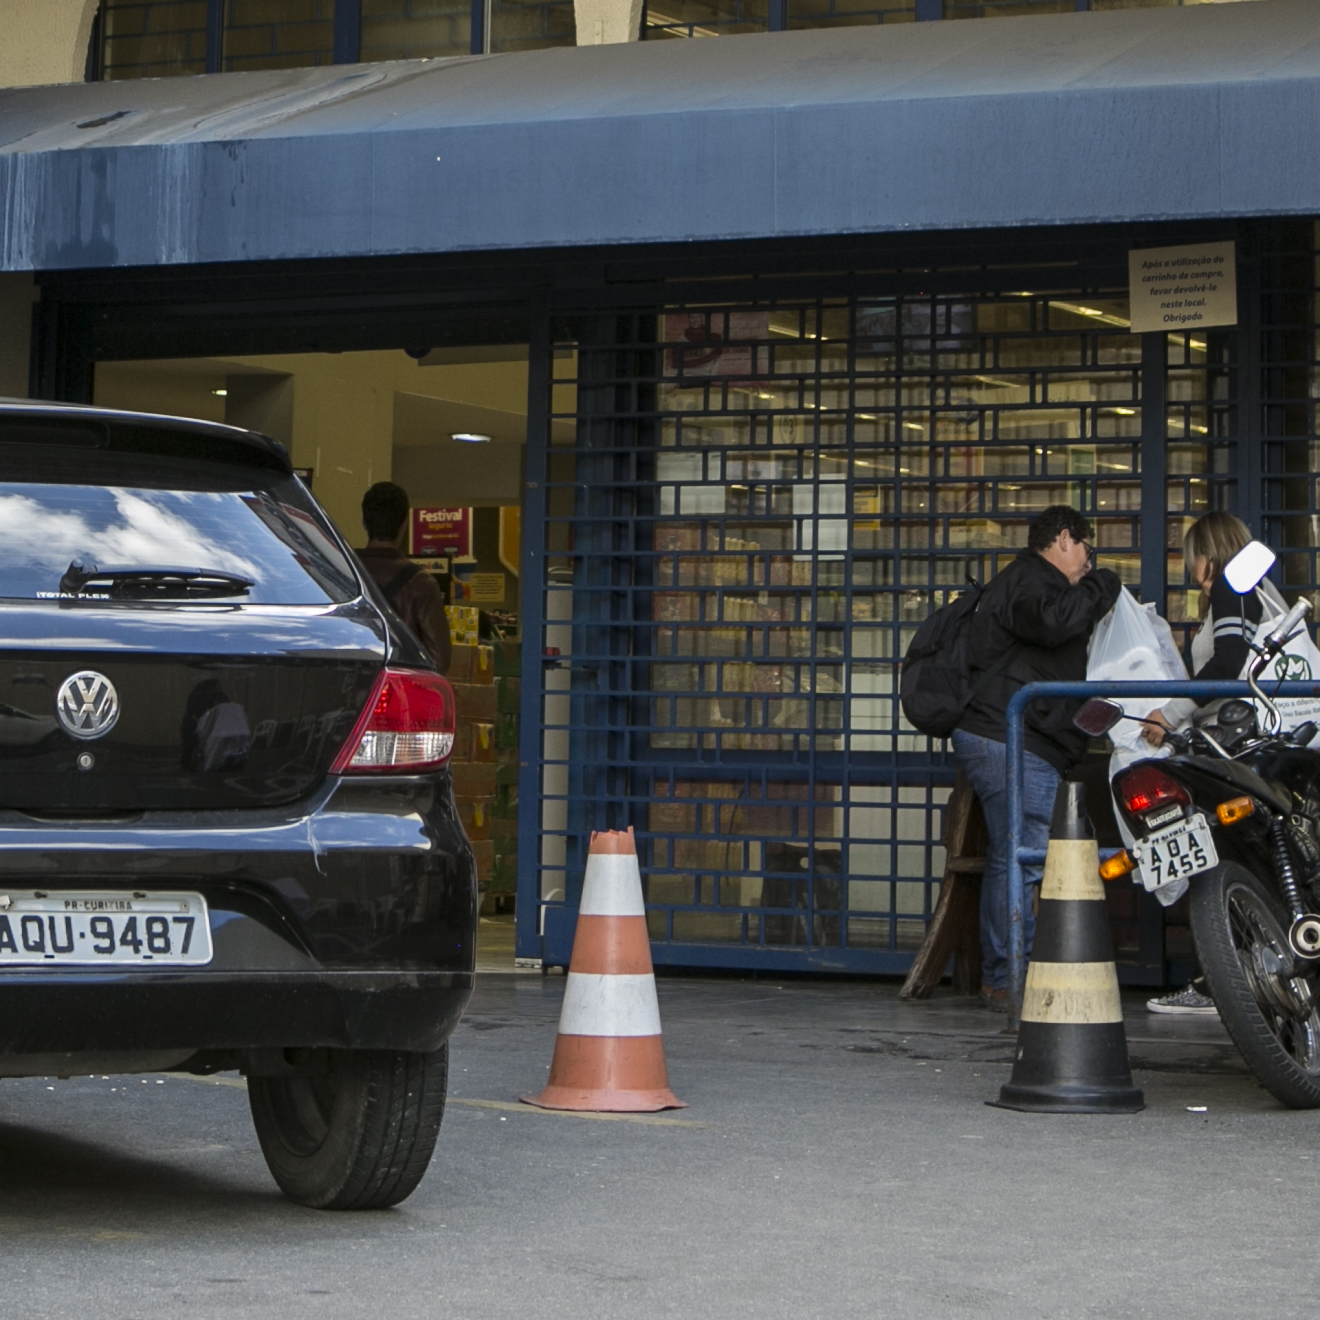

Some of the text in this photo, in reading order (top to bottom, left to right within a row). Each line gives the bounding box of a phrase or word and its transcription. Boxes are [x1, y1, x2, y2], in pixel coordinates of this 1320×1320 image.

[1142, 259, 1162, 270] Após
[1213, 255, 1224, 264] do
[1142, 270, 1224, 283] carrinho de compra,
[1150, 287, 1172, 296] favor
[1160, 298, 1207, 309] neste local.
[1163, 312, 1203, 323] Obrigado
[419, 507, 463, 522] Festival
[1151, 848, 1208, 885] 7455
